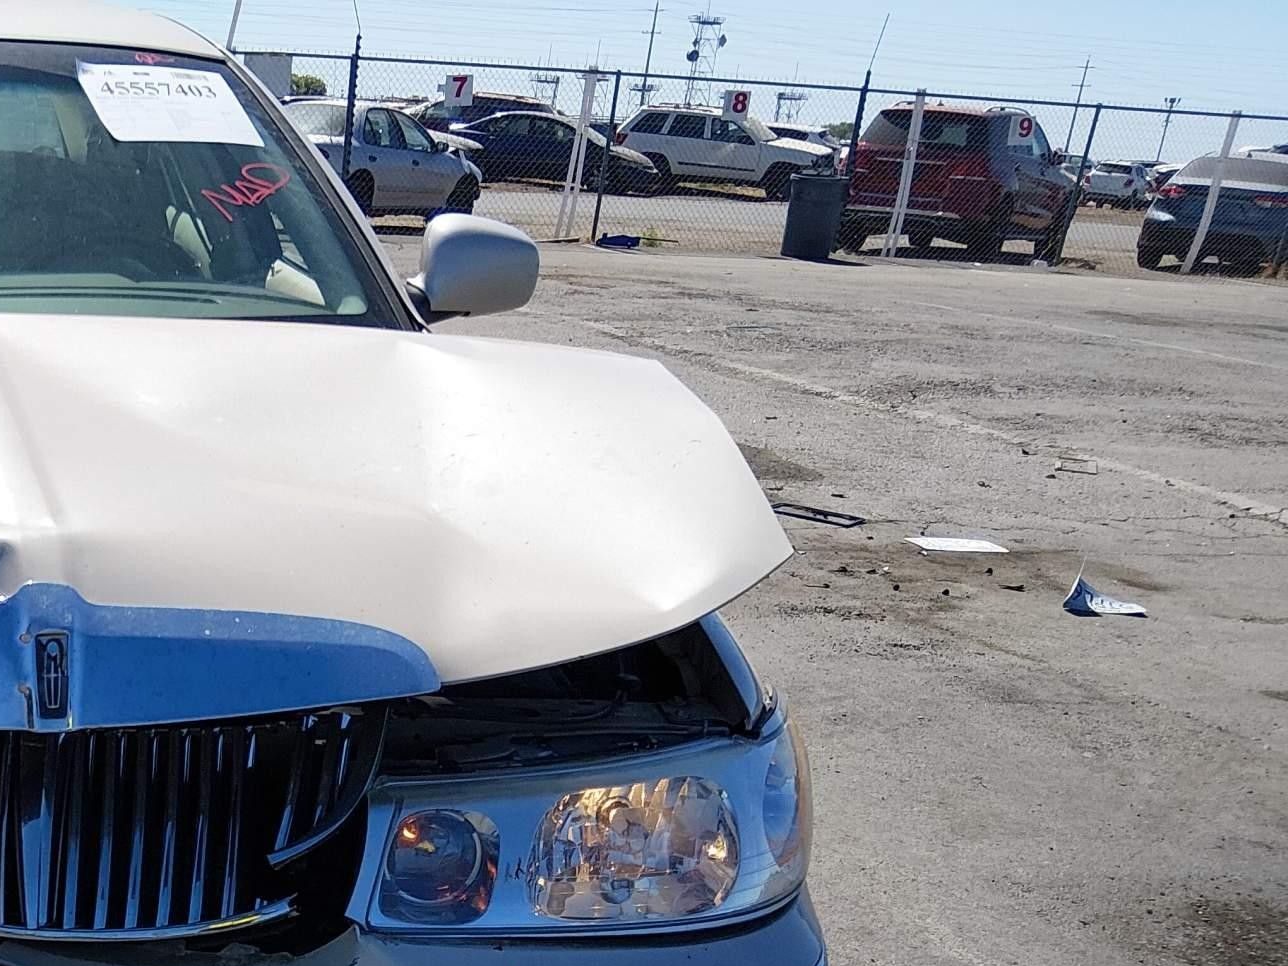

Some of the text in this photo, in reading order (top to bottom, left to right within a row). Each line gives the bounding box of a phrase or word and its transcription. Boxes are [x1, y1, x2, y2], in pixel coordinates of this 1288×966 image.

[99, 80, 218, 99] 45557403
[452, 76, 468, 98] 7
[732, 92, 747, 113] 8
[1019, 117, 1033, 138] 9
